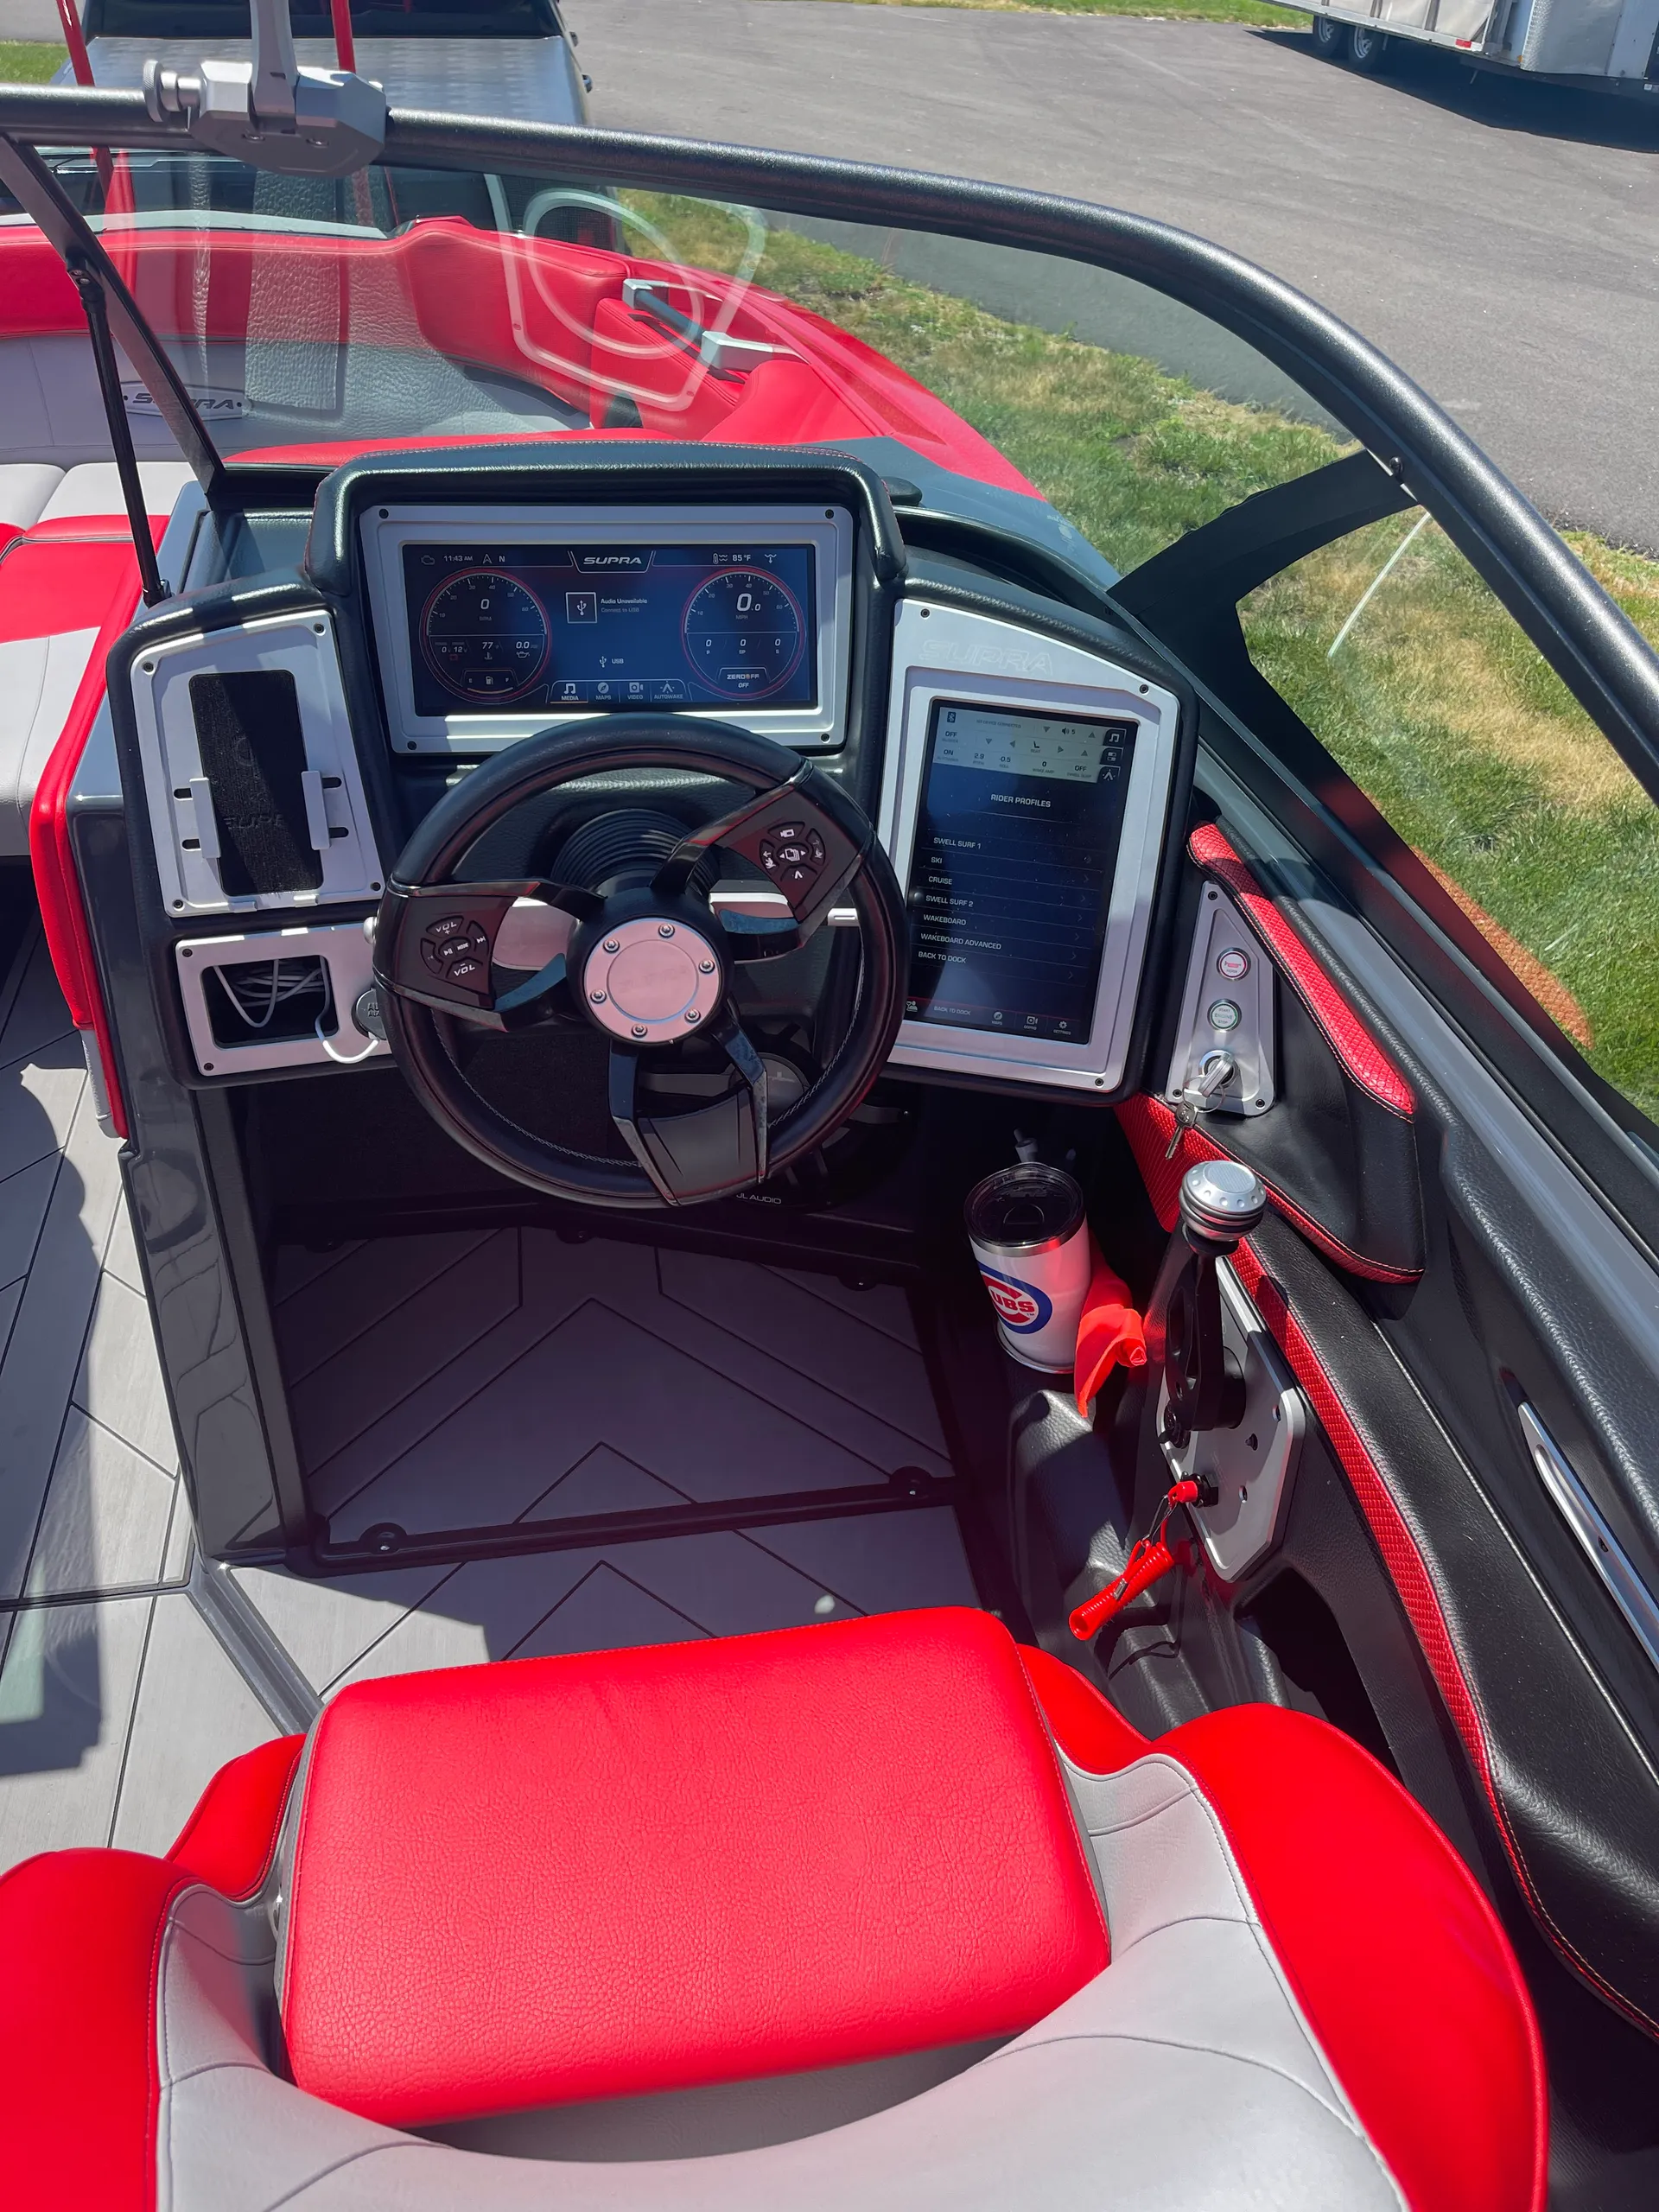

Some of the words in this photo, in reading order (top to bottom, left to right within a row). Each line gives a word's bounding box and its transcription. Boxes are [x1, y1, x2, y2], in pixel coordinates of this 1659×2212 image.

[132, 392, 234, 410] SRA
[583, 556, 642, 565] SUPRA
[480, 599, 490, 610] 0
[481, 641, 493, 650] 77
[515, 641, 530, 650] 0.0
[918, 639, 1053, 677] SUPRA
[990, 793, 1014, 804] RIDER
[1014, 797, 1052, 808] PROFILES
[933, 836, 957, 847] SWELL
[957, 840, 976, 849] SURF
[928, 875, 953, 885] CRUISE
[925, 894, 948, 904] SWELL
[949, 898, 968, 906] SURF
[923, 913, 967, 925] WAKEBOARD
[435, 922, 457, 932] VOL
[920, 932, 963, 944] WAKEBOARD
[964, 938, 1002, 950] ADVANCED
[918, 951, 936, 960] BACK
[454, 964, 475, 976] VOL
[748, 1194, 782, 1205] AUDIO
